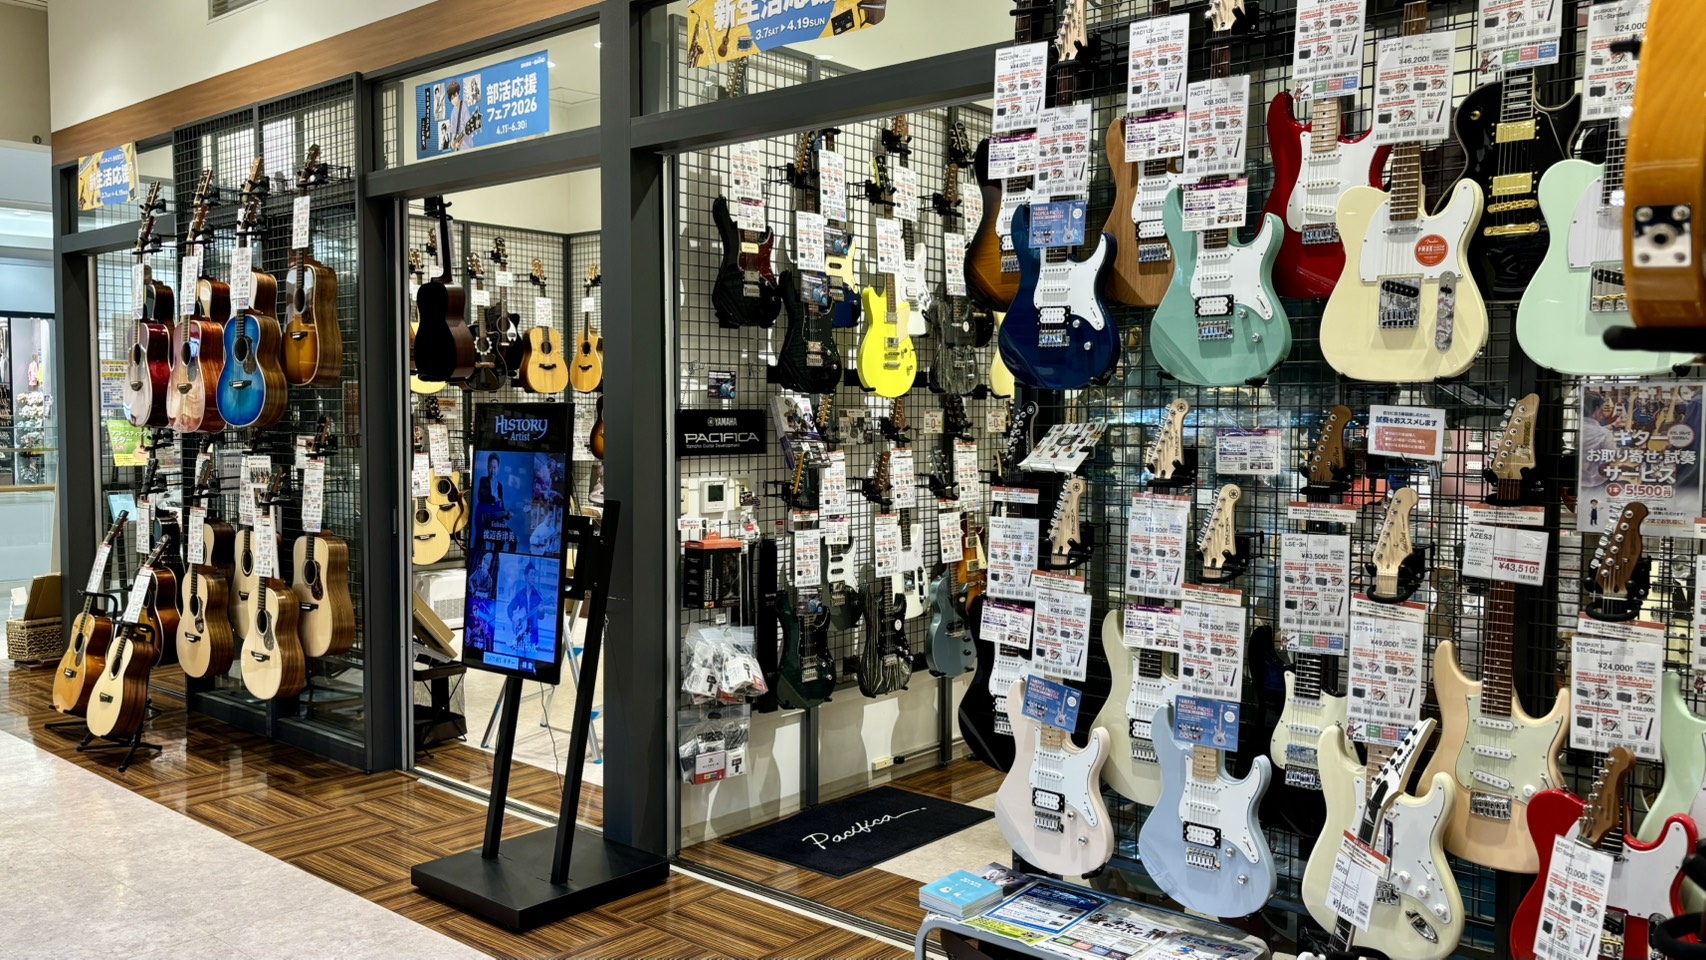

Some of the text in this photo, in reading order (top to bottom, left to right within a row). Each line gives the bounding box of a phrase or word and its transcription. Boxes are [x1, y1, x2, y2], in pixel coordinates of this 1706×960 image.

[713, 0, 837, 32] 新生活
[755, 17, 825, 40] 3.7SAT 4.19SUN
[1399, 56, 1426, 64] ¥46,200
[486, 73, 537, 105] 部活応援
[487, 97, 537, 122] フェア2026
[714, 417, 737, 426] YAMAHA
[1376, 416, 1437, 427] 試奏をおススメします
[511, 432, 531, 442] Artist
[684, 432, 760, 443] PACIFICA
[1613, 429, 1669, 446] ギター
[1586, 448, 1696, 465] お取り寄せ・試奏
[1603, 465, 1677, 484] サービス
[1470, 532, 1495, 541] AZES3
[1499, 562, 1535, 573] ¥43,510
[1598, 662, 1630, 672] ¥24,000
[802, 810, 918, 850] Pacifica
